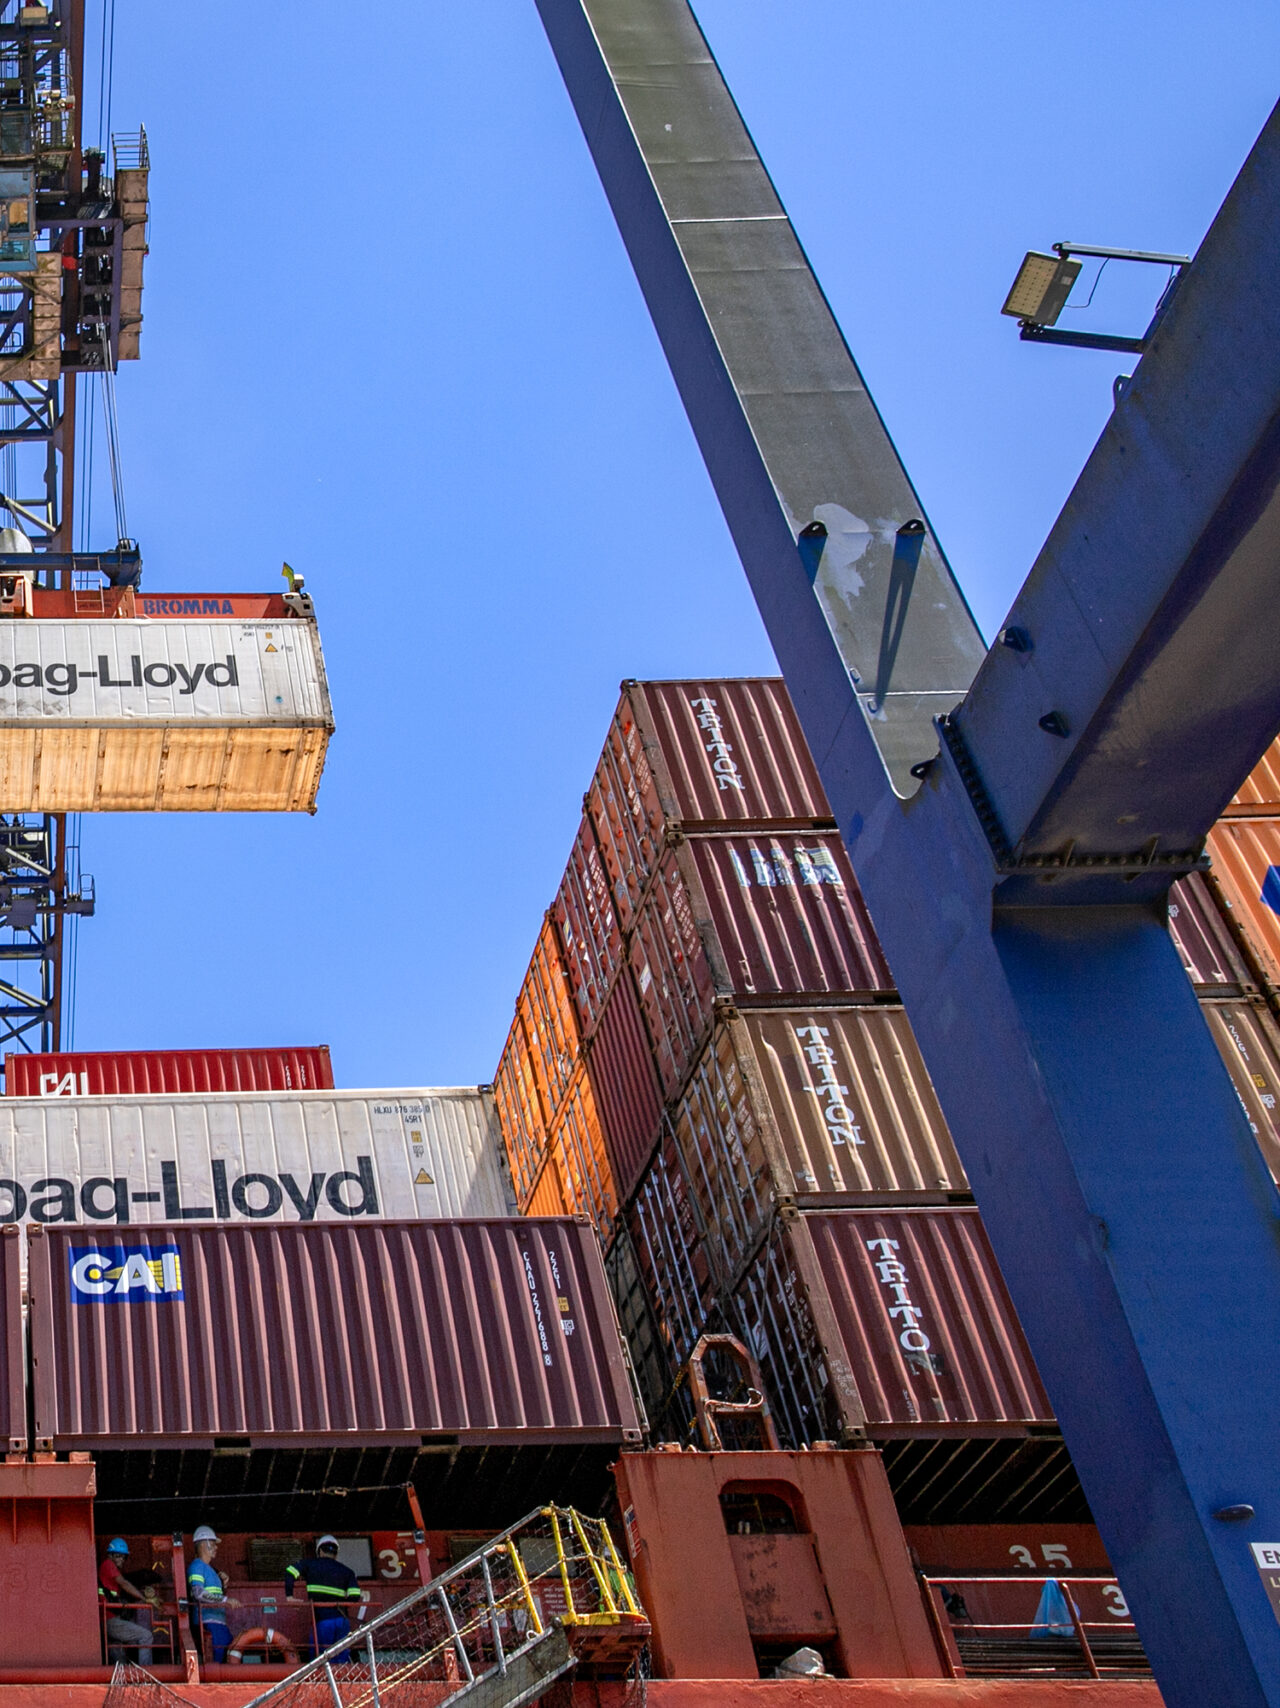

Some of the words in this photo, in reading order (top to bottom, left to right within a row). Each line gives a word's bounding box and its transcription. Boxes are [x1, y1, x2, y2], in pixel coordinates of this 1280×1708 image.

[144, 600, 234, 615] BROMMA
[691, 698, 746, 790] TRITON
[40, 1072, 88, 1096] CAI
[796, 1026, 865, 1145] TRITON
[72, 1253, 178, 1294] CAI
[549, 1251, 561, 1289] 22G1
[523, 1252, 536, 1290] CAAU
[532, 1293, 549, 1351] 227688
[544, 1354, 553, 1366] 8
[867, 1238, 942, 1376] TRITON
[1008, 1544, 1072, 1568] 35
